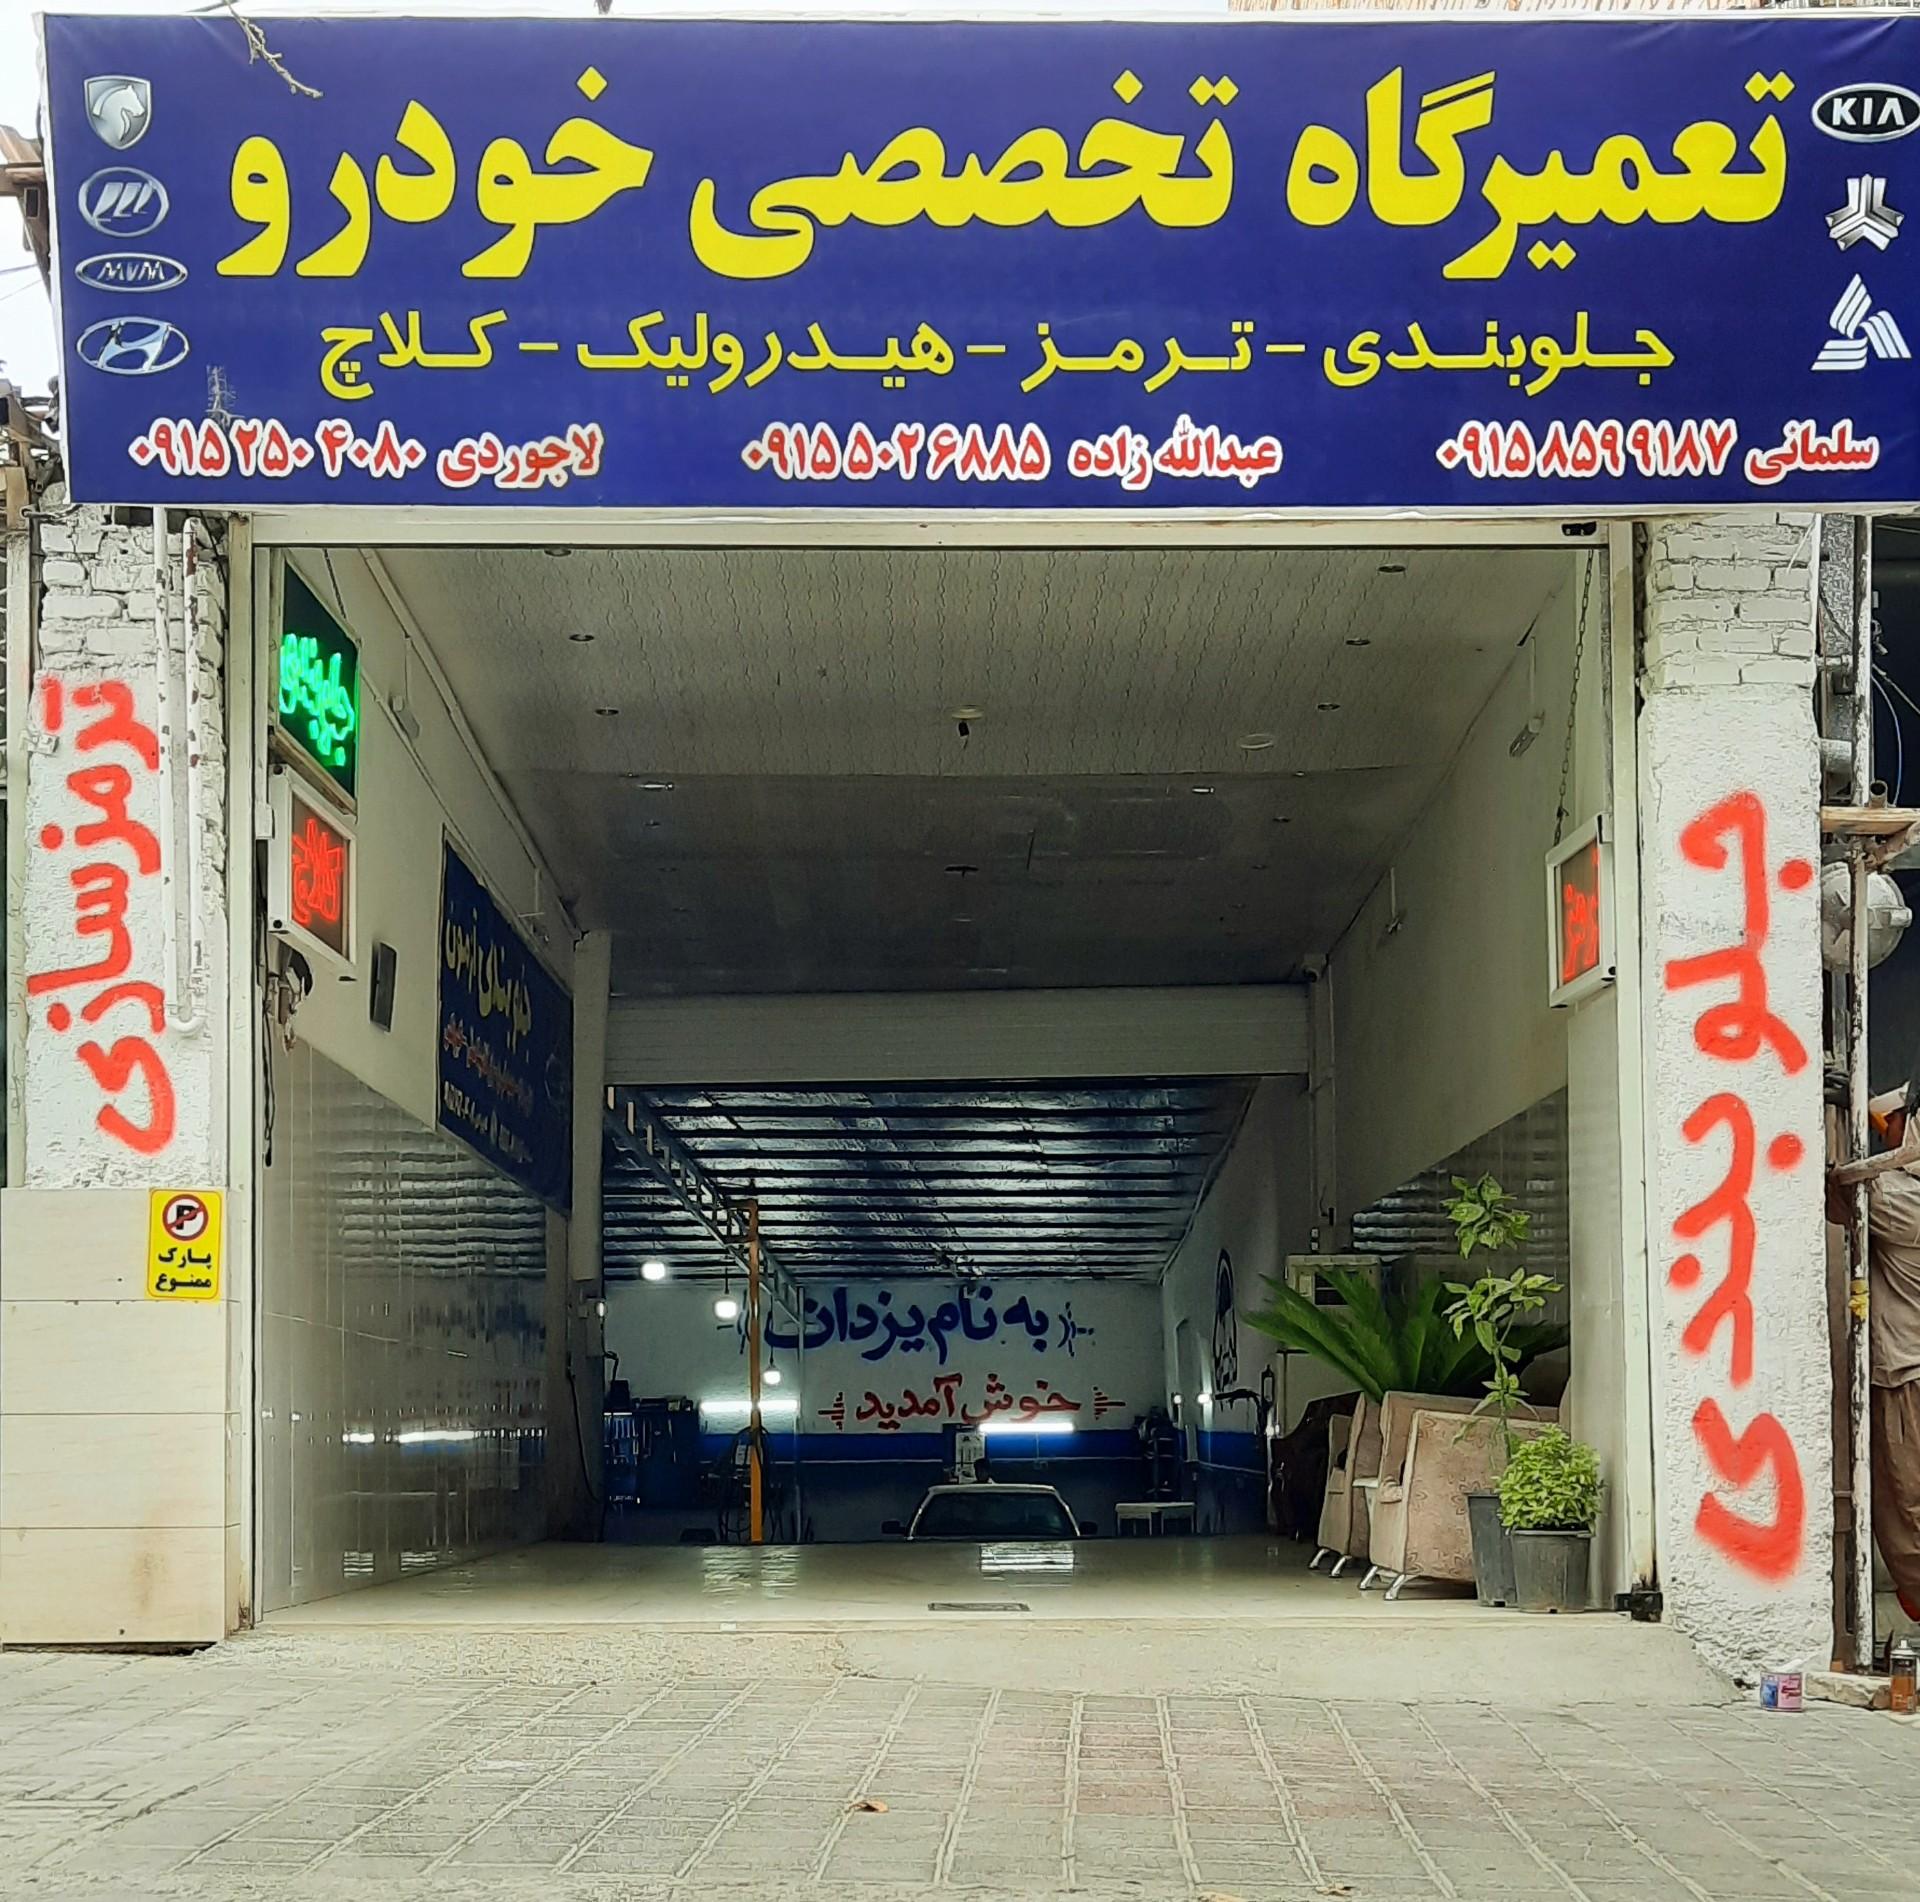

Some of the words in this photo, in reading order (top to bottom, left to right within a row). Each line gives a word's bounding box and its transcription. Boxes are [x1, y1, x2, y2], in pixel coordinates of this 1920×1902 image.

[1831, 97, 1906, 126] KIA
[216, 66, 655, 279] خودرو
[689, 69, 1240, 280] تخصصی
[1286, 66, 1796, 280] تعمیرگاه
[97, 261, 166, 282] MVM
[320, 310, 507, 401] کلاچ
[577, 311, 955, 395] هیدرولیک
[1021, 320, 1255, 393] ترمز
[1323, 311, 1674, 397] جلوبندی
[440, 427, 600, 485] لاجوردی
[1748, 424, 1875, 480] سلمانی
[155, 1273, 212, 1292] ممنوع
[157, 1247, 212, 1270] پارک
[762, 1286, 926, 1362] یزدان
[926, 1285, 998, 1365] نام
[1002, 1295, 1049, 1353] به
[855, 1372, 962, 1431] آمدید
[960, 1372, 1082, 1425] خوش
